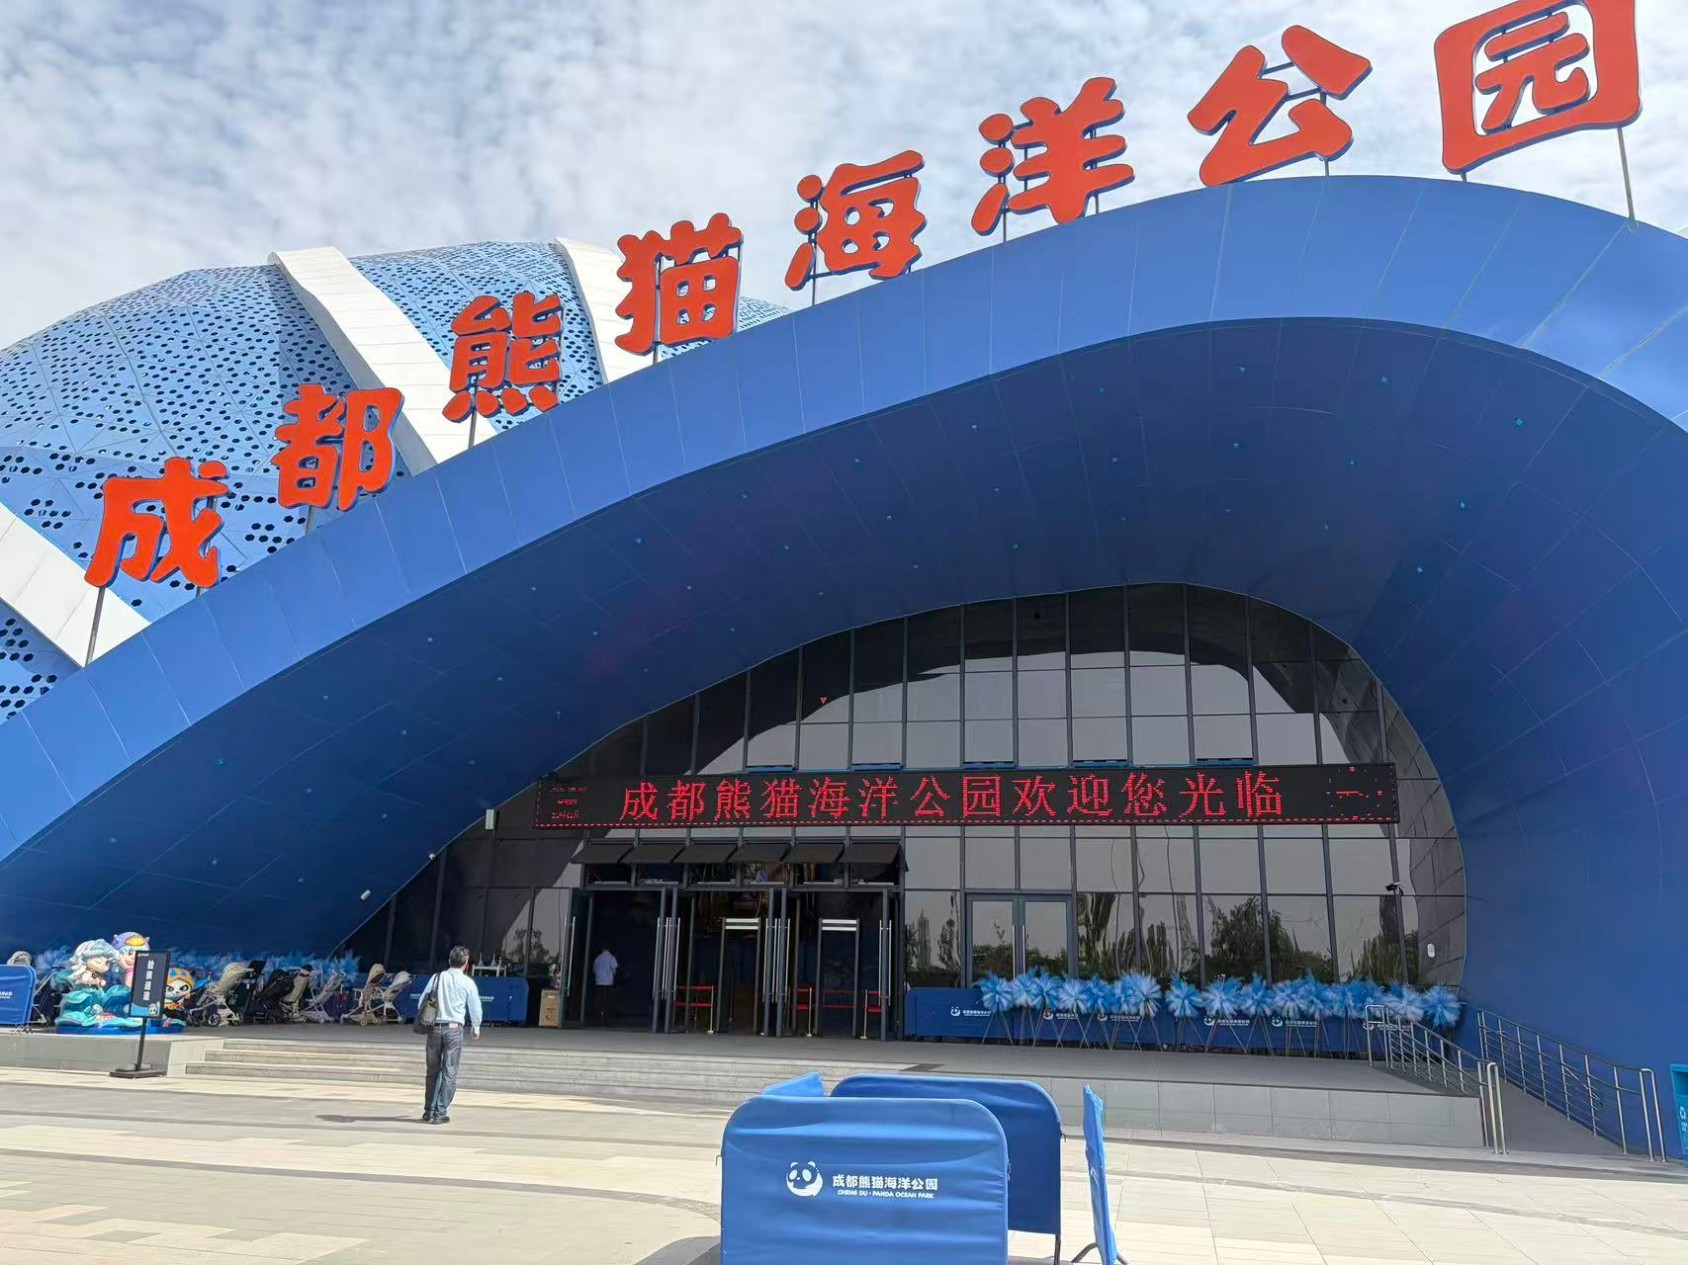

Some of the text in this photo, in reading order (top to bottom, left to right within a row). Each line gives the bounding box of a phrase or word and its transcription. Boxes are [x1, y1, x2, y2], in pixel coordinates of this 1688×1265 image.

[84, 0, 1641, 589] 成都熊猫海洋公园
[620, 771, 1283, 821] 成都熊猫海洋公园欢迎您光临
[832, 1174, 938, 1191] 成都熊猫海洋公园
